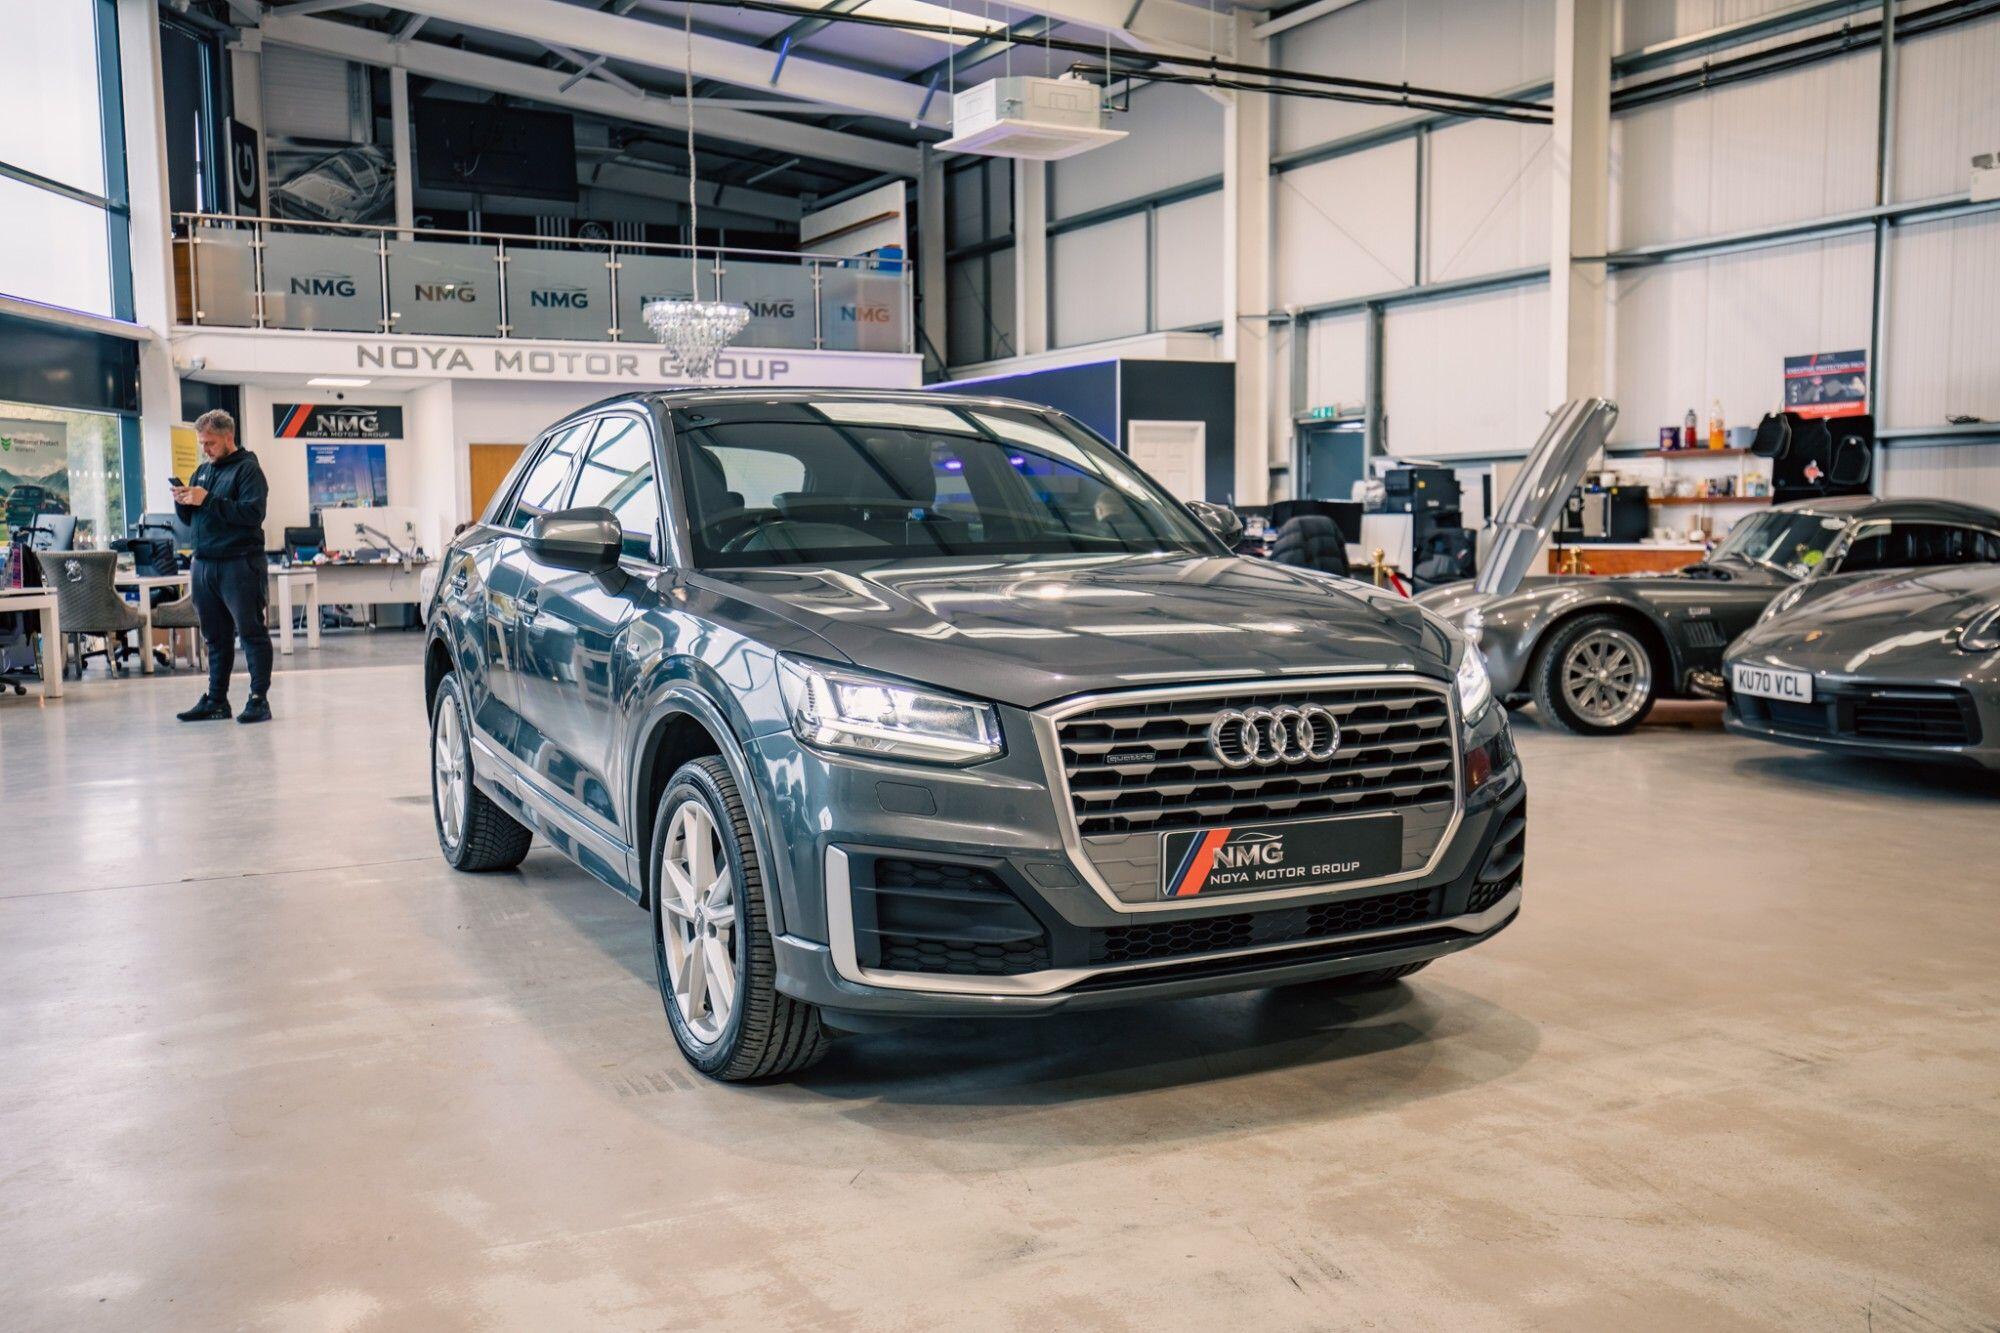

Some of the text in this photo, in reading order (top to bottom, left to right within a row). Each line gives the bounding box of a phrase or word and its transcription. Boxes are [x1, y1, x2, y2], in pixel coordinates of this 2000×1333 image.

[290, 277, 356, 297] NMG
[414, 284, 476, 303] NMG
[530, 290, 589, 308] NMG
[841, 306, 890, 322] NMG
[357, 345, 789, 381] NOYA MOTOR GOUP
[316, 415, 379, 432] NMG
[1739, 670, 1804, 697] KU70 VCL
[1109, 753, 1153, 763] quattro
[1212, 842, 1284, 869] NMG
[1210, 861, 1360, 885] NOYA MOTOR GROUP
